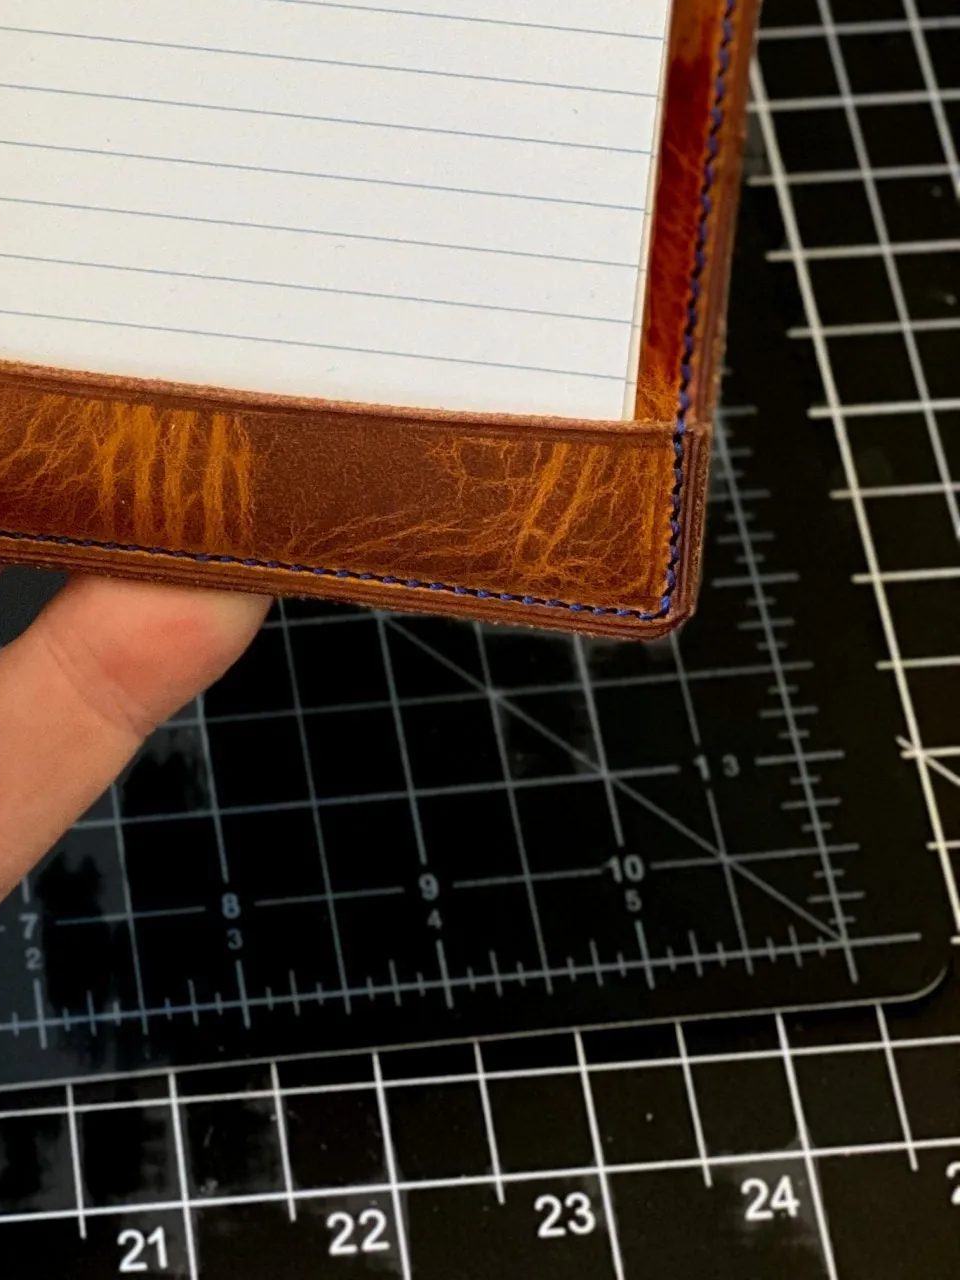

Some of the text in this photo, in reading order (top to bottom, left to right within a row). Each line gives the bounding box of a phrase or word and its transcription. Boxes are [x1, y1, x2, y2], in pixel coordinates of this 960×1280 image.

[609, 853, 646, 883] 10
[417, 873, 440, 902] 9
[220, 892, 241, 920] 8
[625, 890, 644, 913] 5
[19, 912, 38, 939] 7
[425, 907, 444, 930] 4
[226, 928, 244, 951] 3
[25, 946, 43, 971] 2
[117, 1226, 169, 1272] 21
[326, 1209, 390, 1256] 22
[534, 1192, 596, 1238] 23
[741, 1175, 800, 1220] 24
